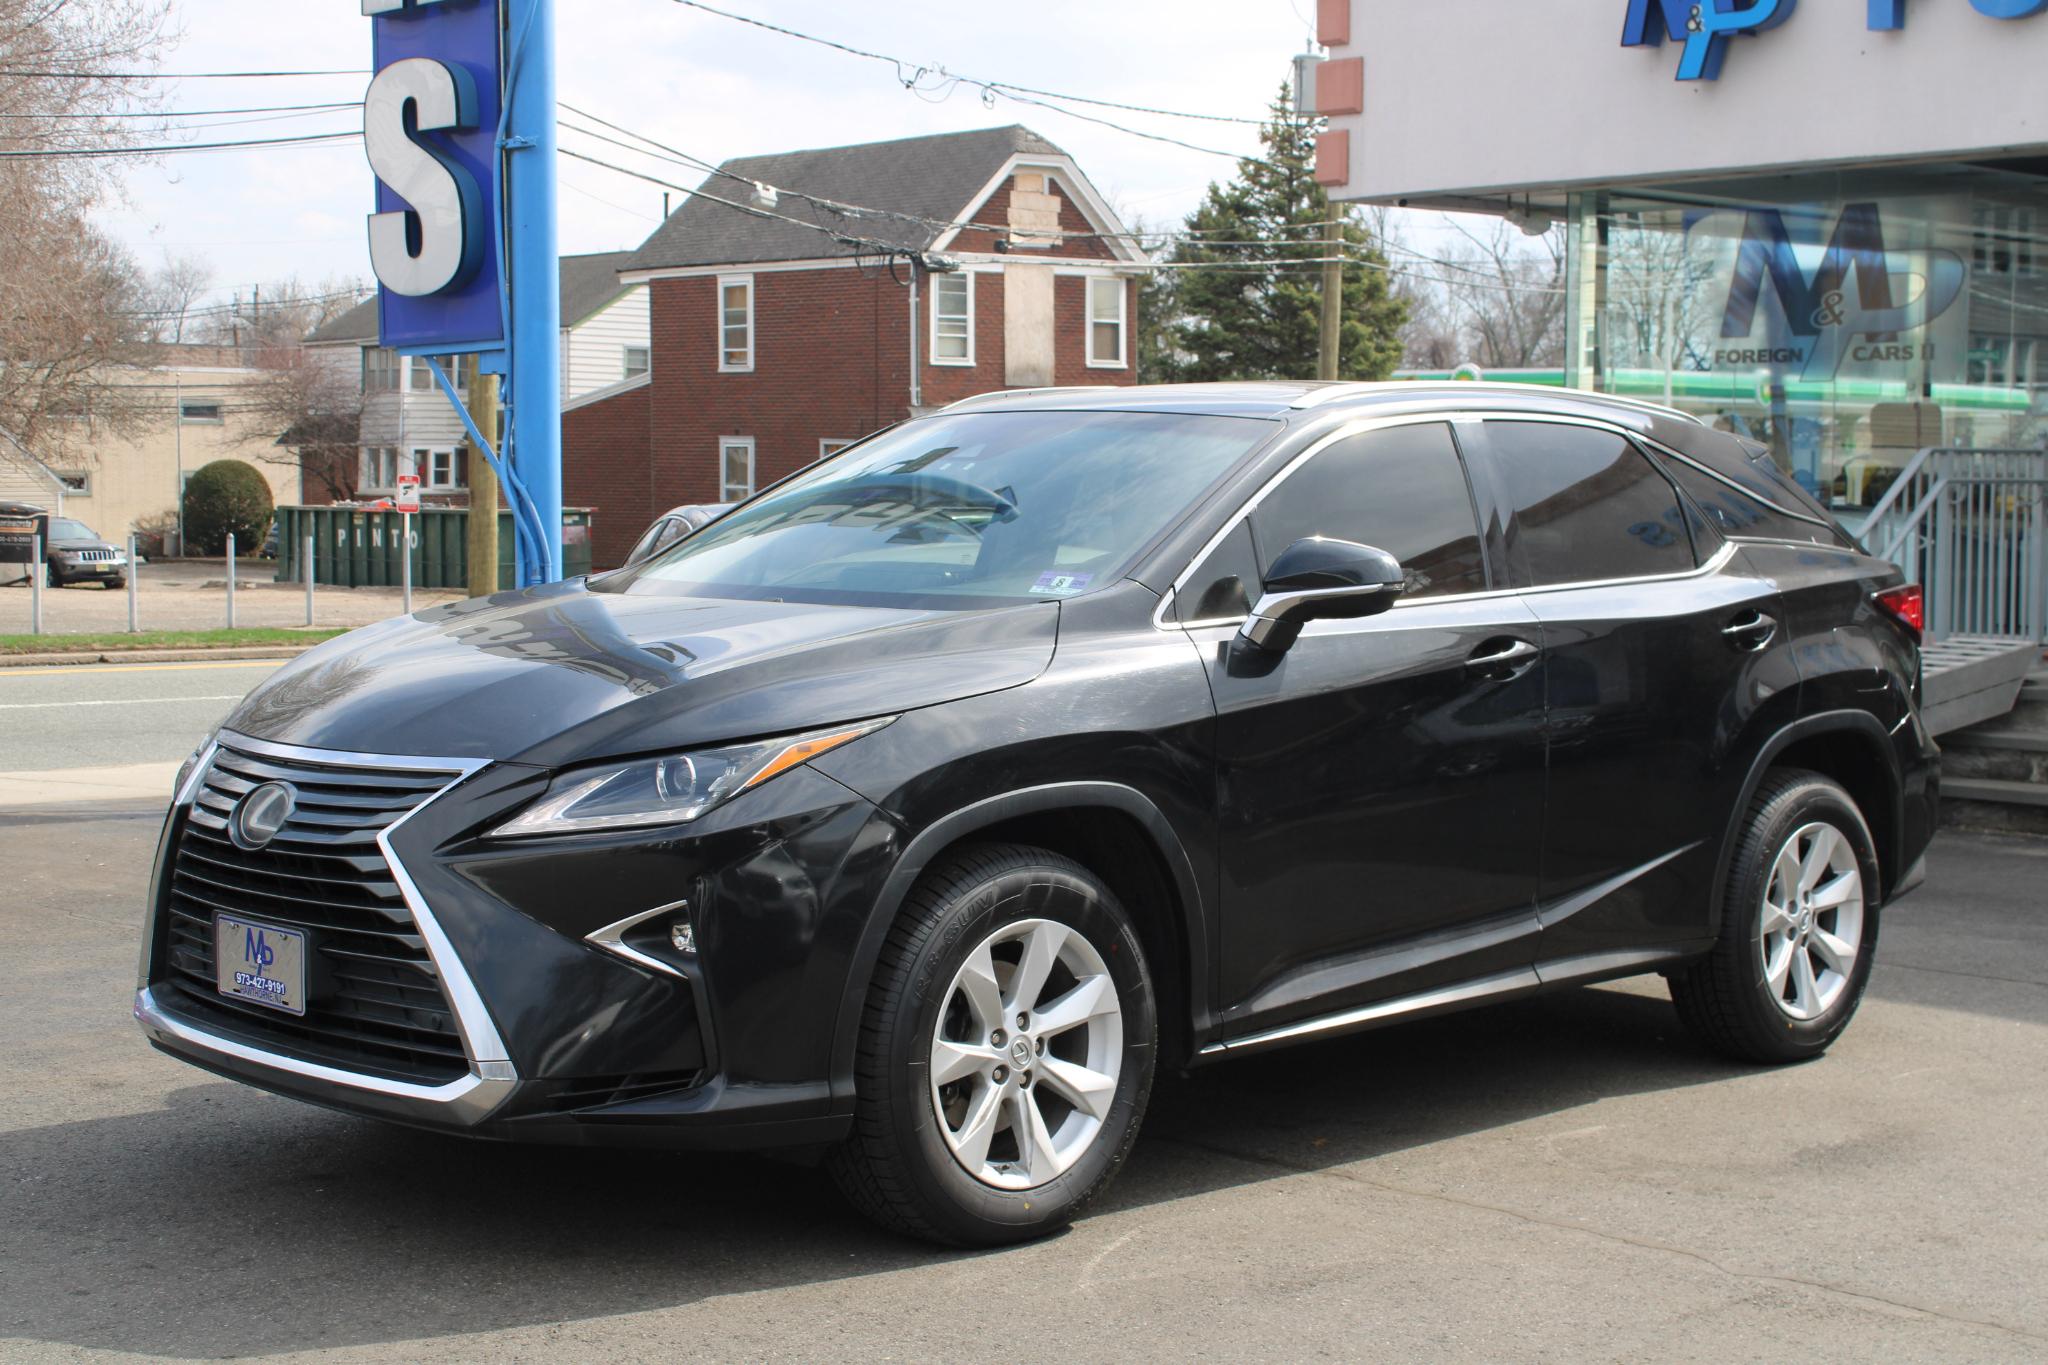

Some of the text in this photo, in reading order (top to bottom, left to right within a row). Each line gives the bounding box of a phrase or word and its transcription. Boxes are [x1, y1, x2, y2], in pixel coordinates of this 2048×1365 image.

[1715, 347, 1804, 365] FOREIGN
[1851, 344, 1914, 361] CARS
[337, 528, 418, 549] PINTO
[236, 972, 285, 995] 973-427-9191
